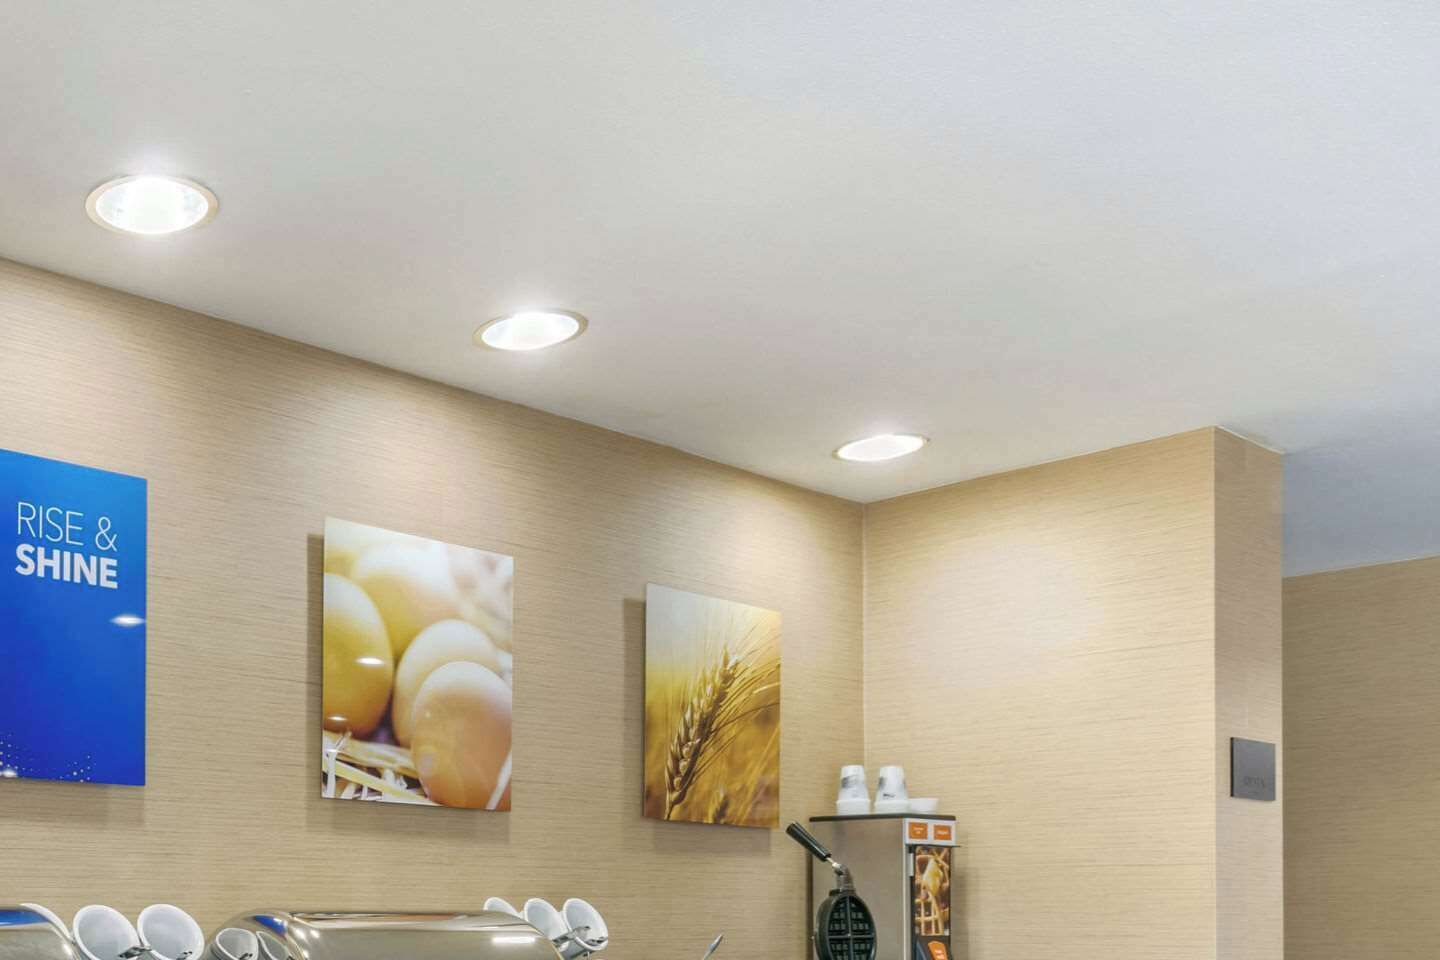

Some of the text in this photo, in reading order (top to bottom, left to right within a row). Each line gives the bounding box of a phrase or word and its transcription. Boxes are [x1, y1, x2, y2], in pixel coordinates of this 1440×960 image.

[16, 501, 118, 552] RISE &
[15, 543, 119, 590] SHINE
